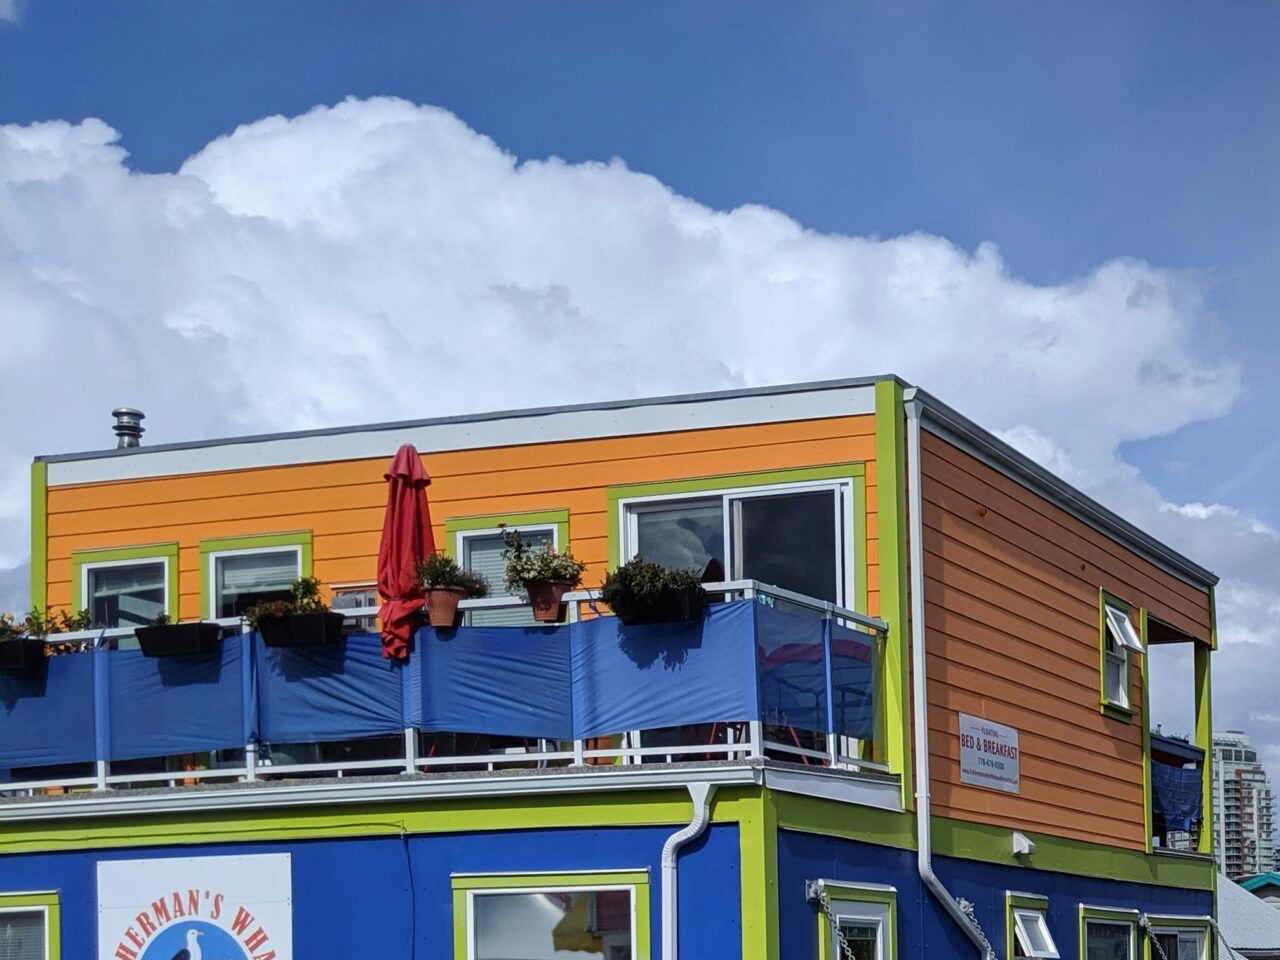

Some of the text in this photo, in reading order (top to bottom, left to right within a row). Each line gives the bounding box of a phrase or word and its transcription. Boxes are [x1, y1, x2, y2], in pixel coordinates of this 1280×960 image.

[961, 733, 1018, 761] BED & BREAKFAST
